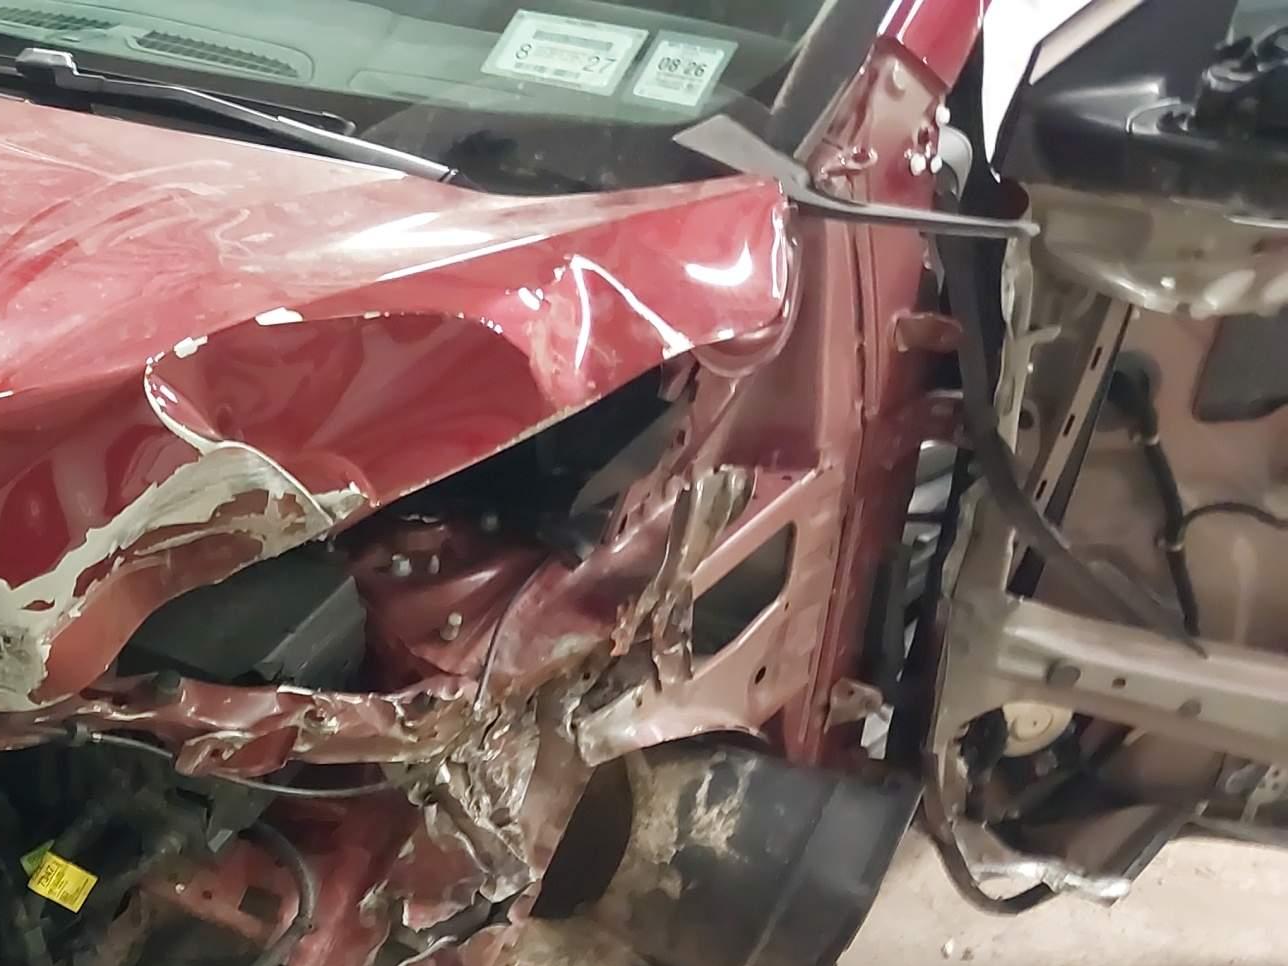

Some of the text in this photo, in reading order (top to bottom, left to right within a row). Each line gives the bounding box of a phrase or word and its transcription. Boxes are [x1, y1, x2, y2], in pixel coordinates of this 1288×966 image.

[515, 43, 533, 60] 8
[582, 56, 616, 73] 27
[657, 56, 682, 73] 08
